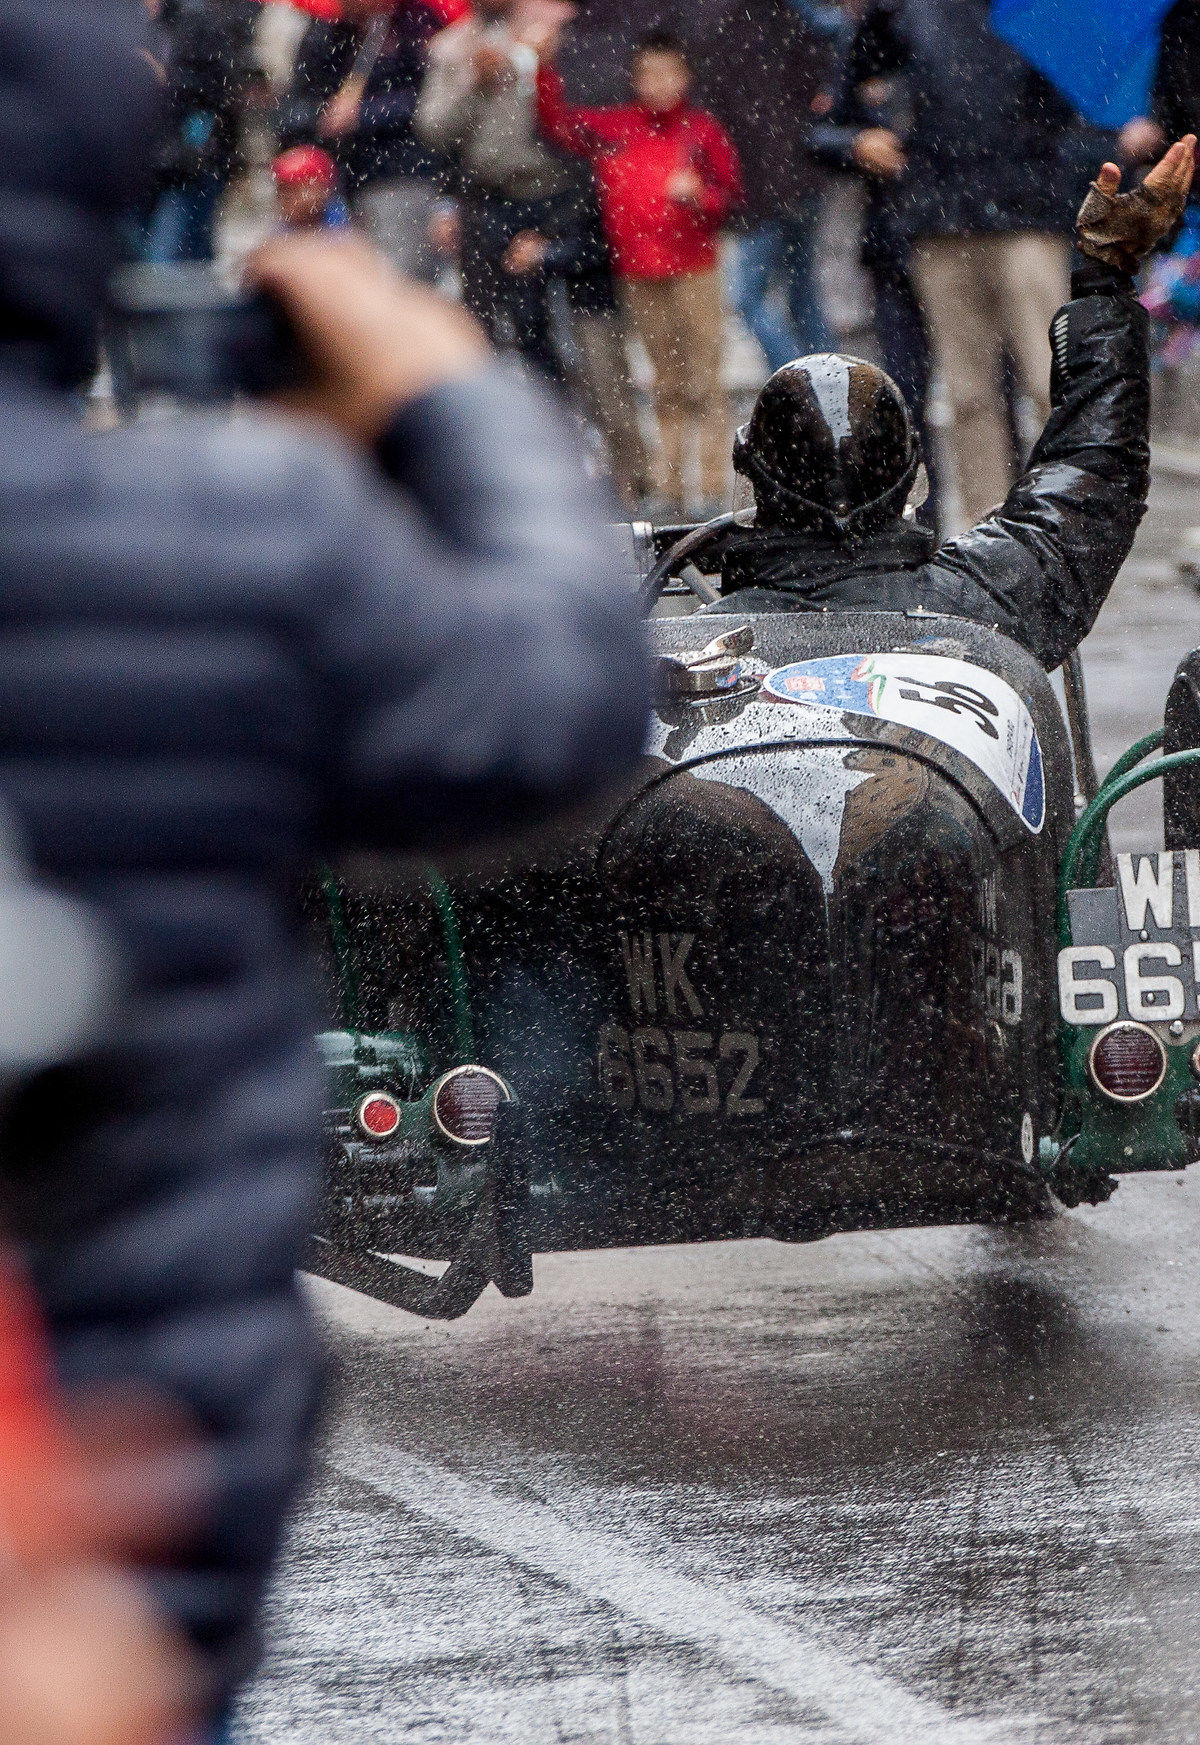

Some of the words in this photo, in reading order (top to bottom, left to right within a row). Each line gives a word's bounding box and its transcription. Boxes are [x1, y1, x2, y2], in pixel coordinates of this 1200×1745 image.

[893, 676, 1000, 740] 56
[618, 931, 704, 1018] WK
[598, 1024, 766, 1116] 6652
